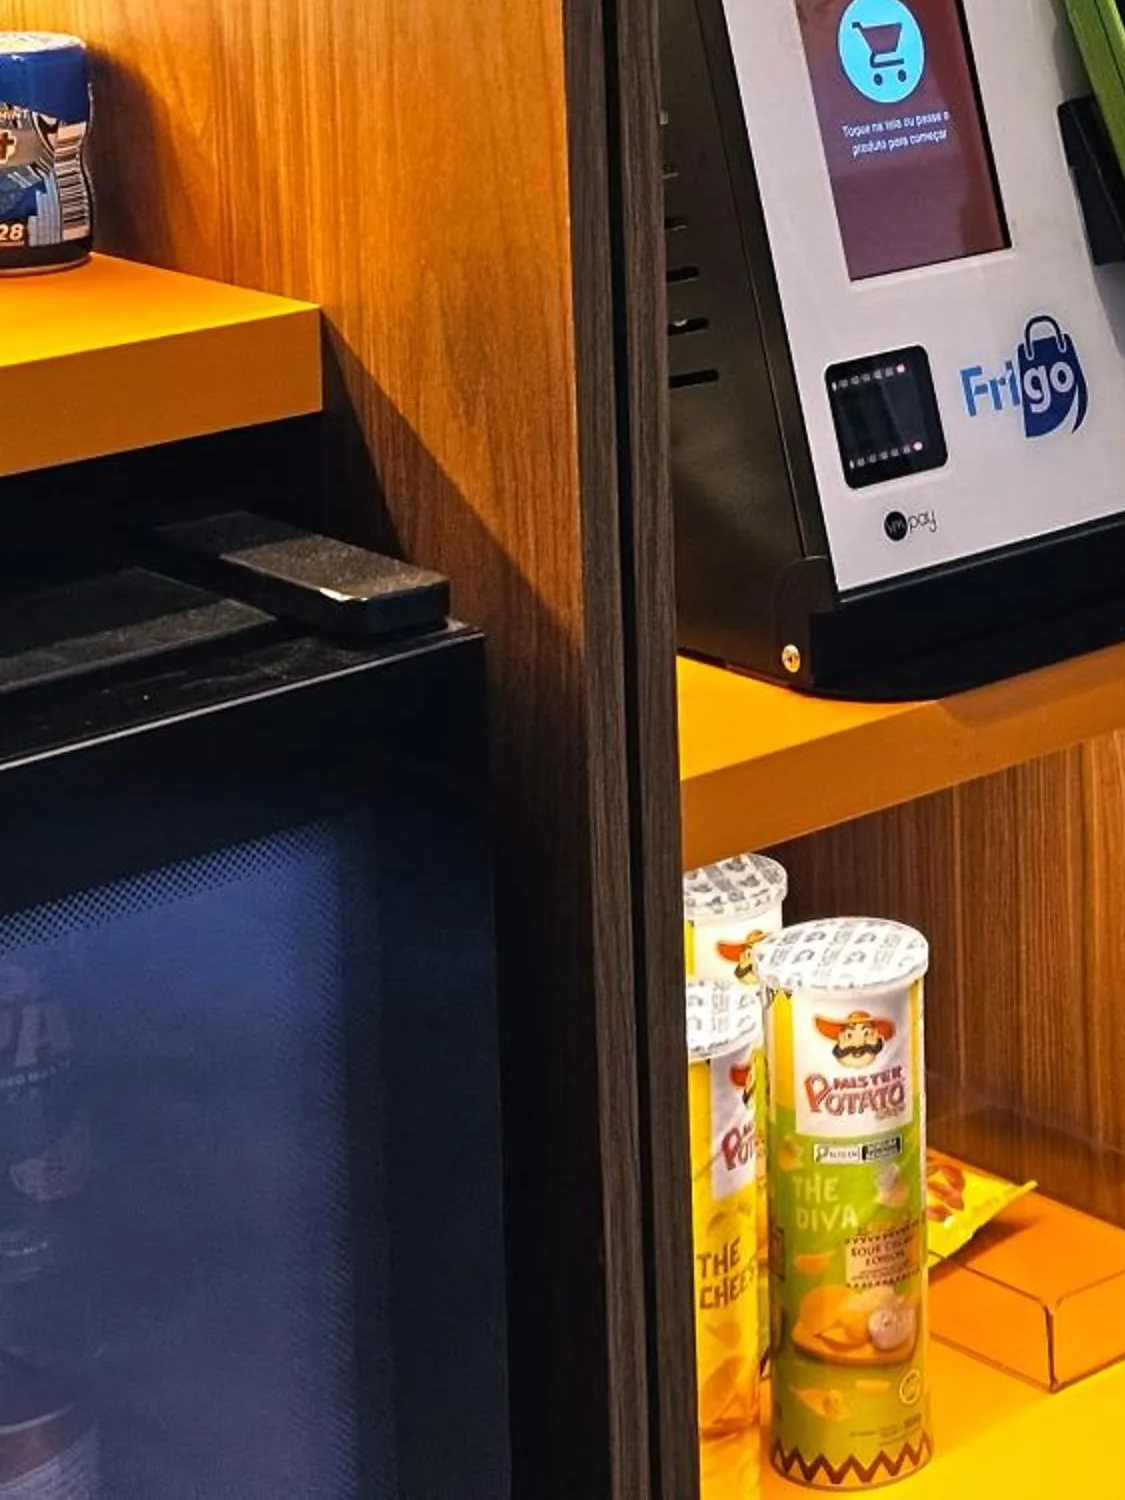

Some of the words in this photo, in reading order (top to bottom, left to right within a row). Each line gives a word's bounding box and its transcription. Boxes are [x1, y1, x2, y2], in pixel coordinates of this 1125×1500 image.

[960, 360, 1075, 417] Frigo
[908, 509, 937, 533] pay
[833, 1065, 903, 1091] MISTER
[804, 1073, 905, 1117] POTATO
[792, 1172, 839, 1205] THE
[795, 1203, 859, 1233] DIVA
[697, 1235, 741, 1279] THE
